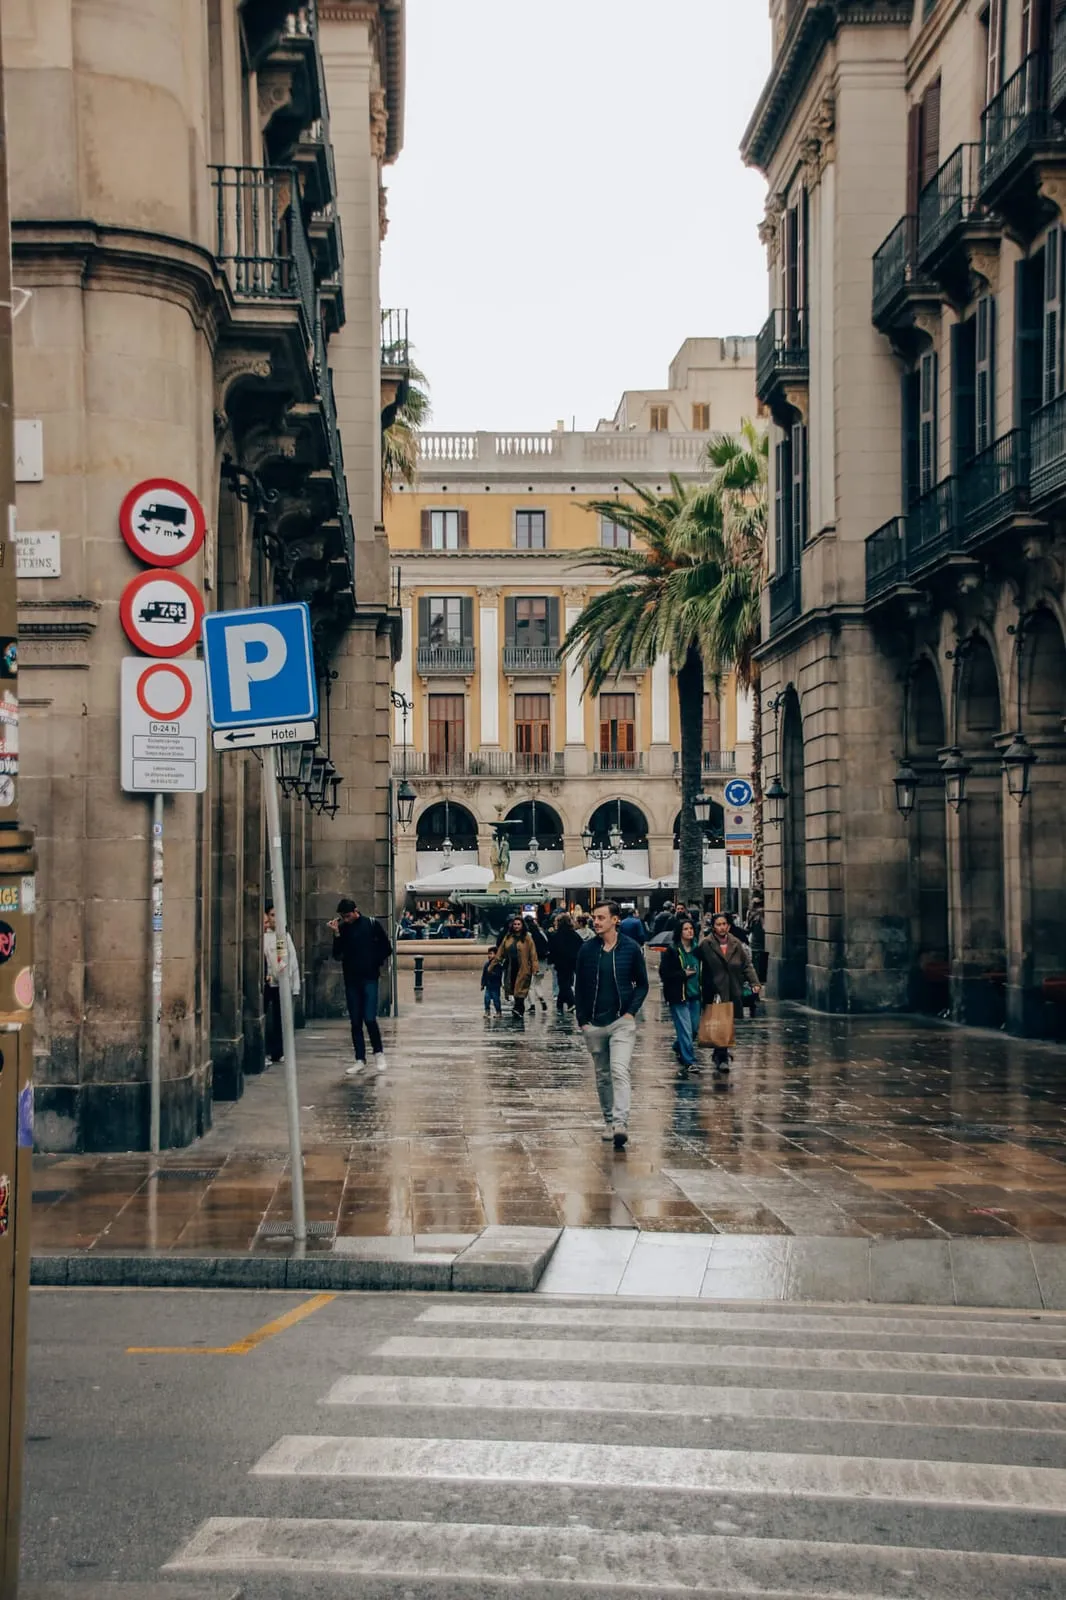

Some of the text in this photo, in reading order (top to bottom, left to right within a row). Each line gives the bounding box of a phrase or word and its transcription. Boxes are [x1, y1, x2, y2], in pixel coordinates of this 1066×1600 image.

[155, 526, 173, 537] 7 m
[224, 622, 288, 712] P
[271, 727, 297, 740] Hotel
